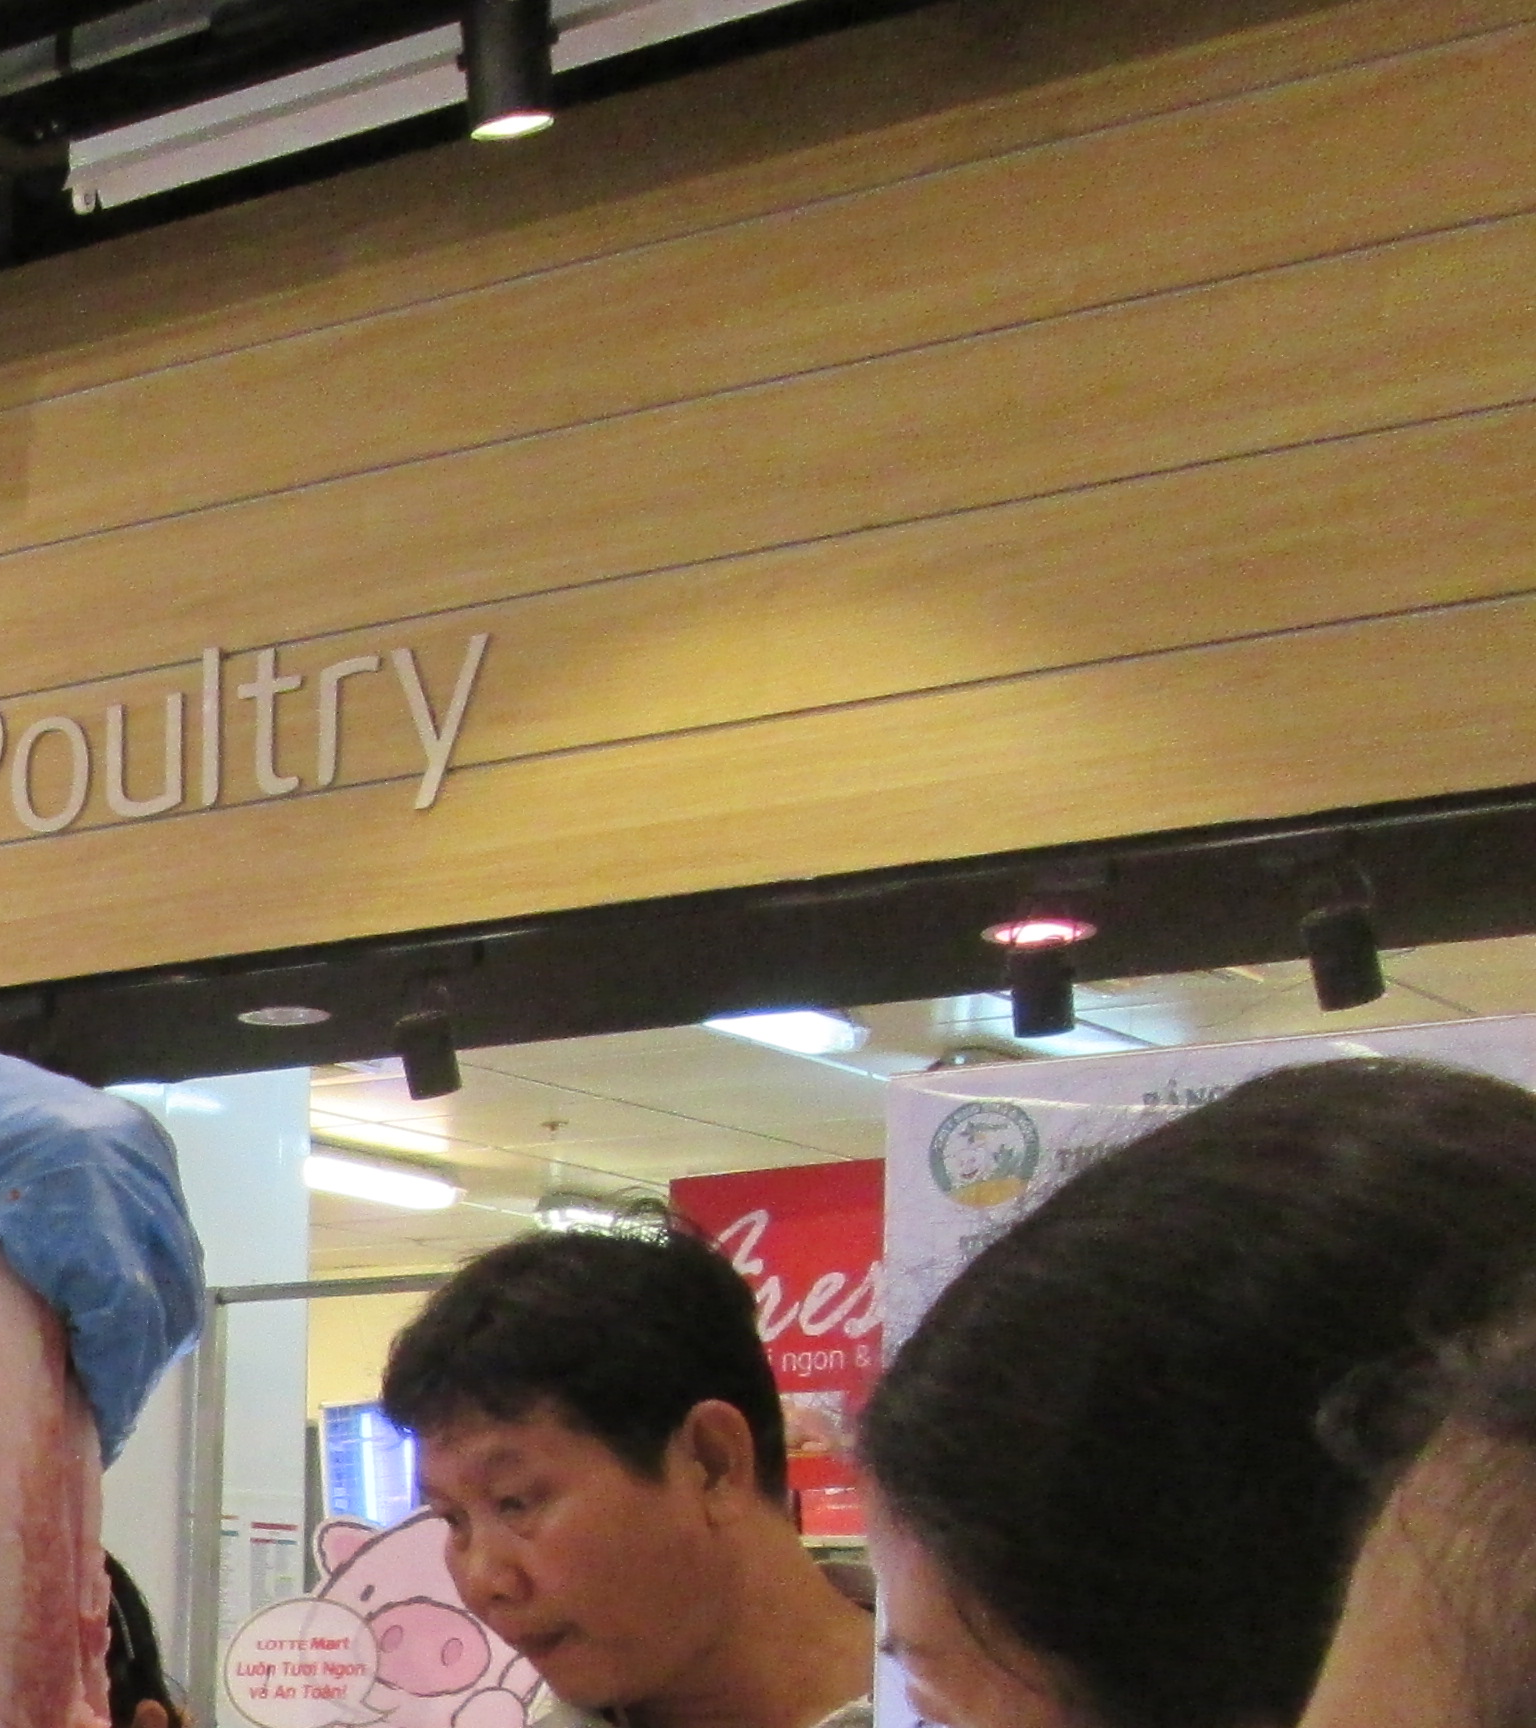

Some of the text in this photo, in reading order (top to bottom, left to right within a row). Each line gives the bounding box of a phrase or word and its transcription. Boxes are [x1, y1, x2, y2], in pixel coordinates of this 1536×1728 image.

[782, 1350, 844, 1377] ngon
[856, 1345, 871, 1367] &
[256, 1637, 350, 1651] LOTTE Mart
[237, 1662, 277, 1676] Luôn
[324, 1662, 366, 1679] Ngon
[274, 1685, 296, 1699] An
